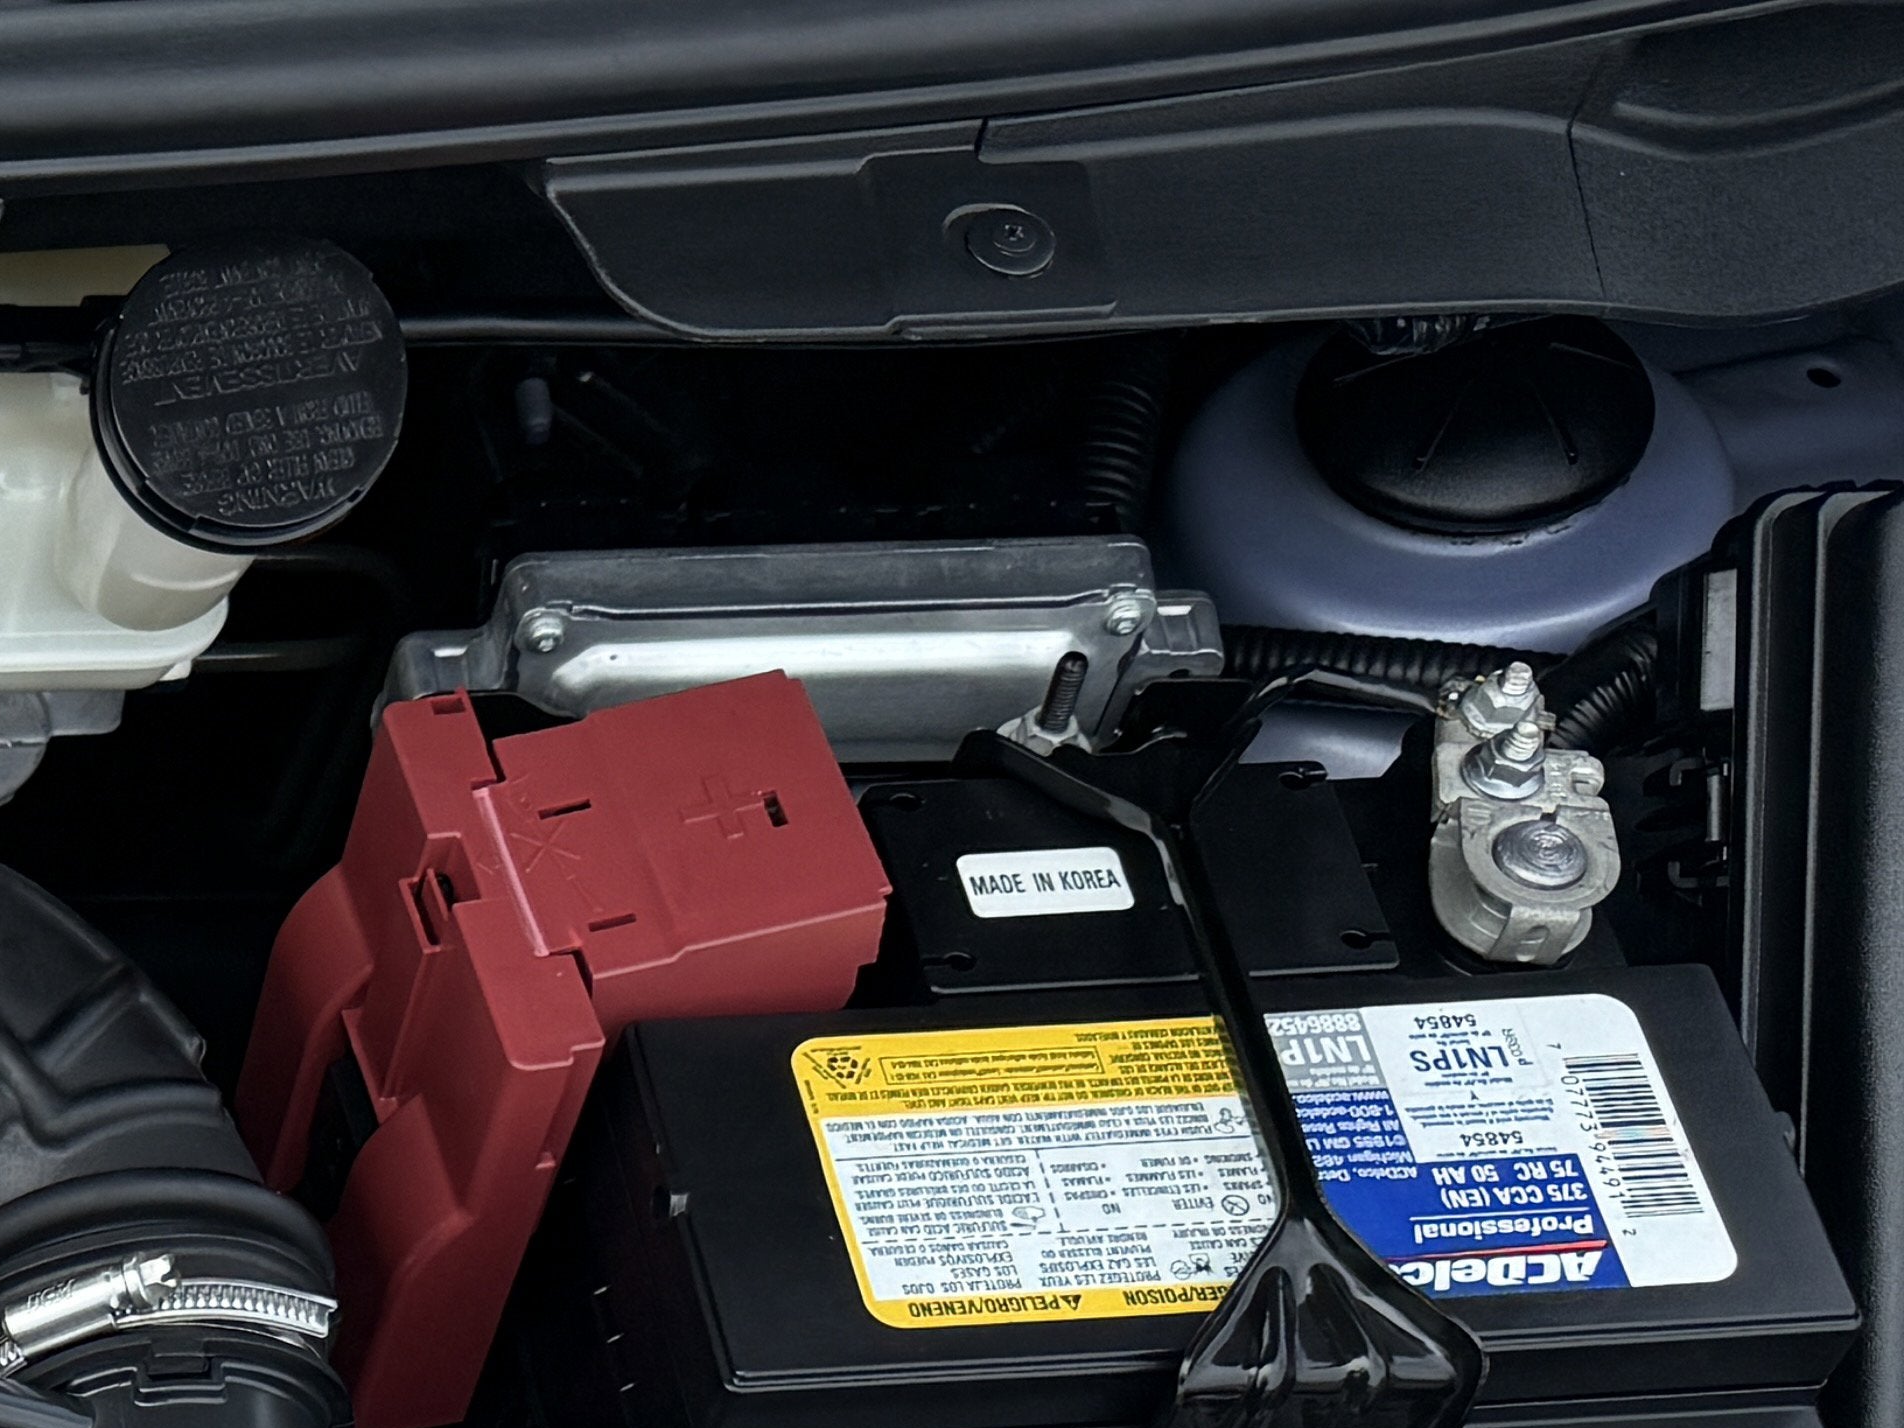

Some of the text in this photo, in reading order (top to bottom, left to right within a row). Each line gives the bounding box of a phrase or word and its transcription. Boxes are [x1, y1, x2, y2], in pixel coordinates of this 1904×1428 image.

[968, 869, 1122, 896] MADE IN KOREA
[1413, 1013, 1477, 1030] 54854
[1409, 1045, 1509, 1072] LN1PS
[1459, 1130, 1524, 1147] 54854
[1346, 1149, 1414, 1165] Michigan
[1352, 1166, 1418, 1180] ACDelco,
[1431, 1159, 1579, 1186] 75 RC 50 AH
[1440, 1182, 1588, 1209] 375 CCA (EN)
[1101, 1203, 1122, 1215] NO
[1414, 1214, 1594, 1244] Professional
[1107, 1257, 1132, 1270] GAZ
[1133, 1256, 1157, 1268] LES
[950, 1264, 1018, 1279] LOS GASES
[1073, 1273, 1097, 1286] LES
[1098, 1269, 1162, 1284] PROTEGEZ
[901, 1278, 1022, 1296] PROTEJA LOS OJOS
[907, 1294, 1061, 1318] PELIGRO/VENENO
